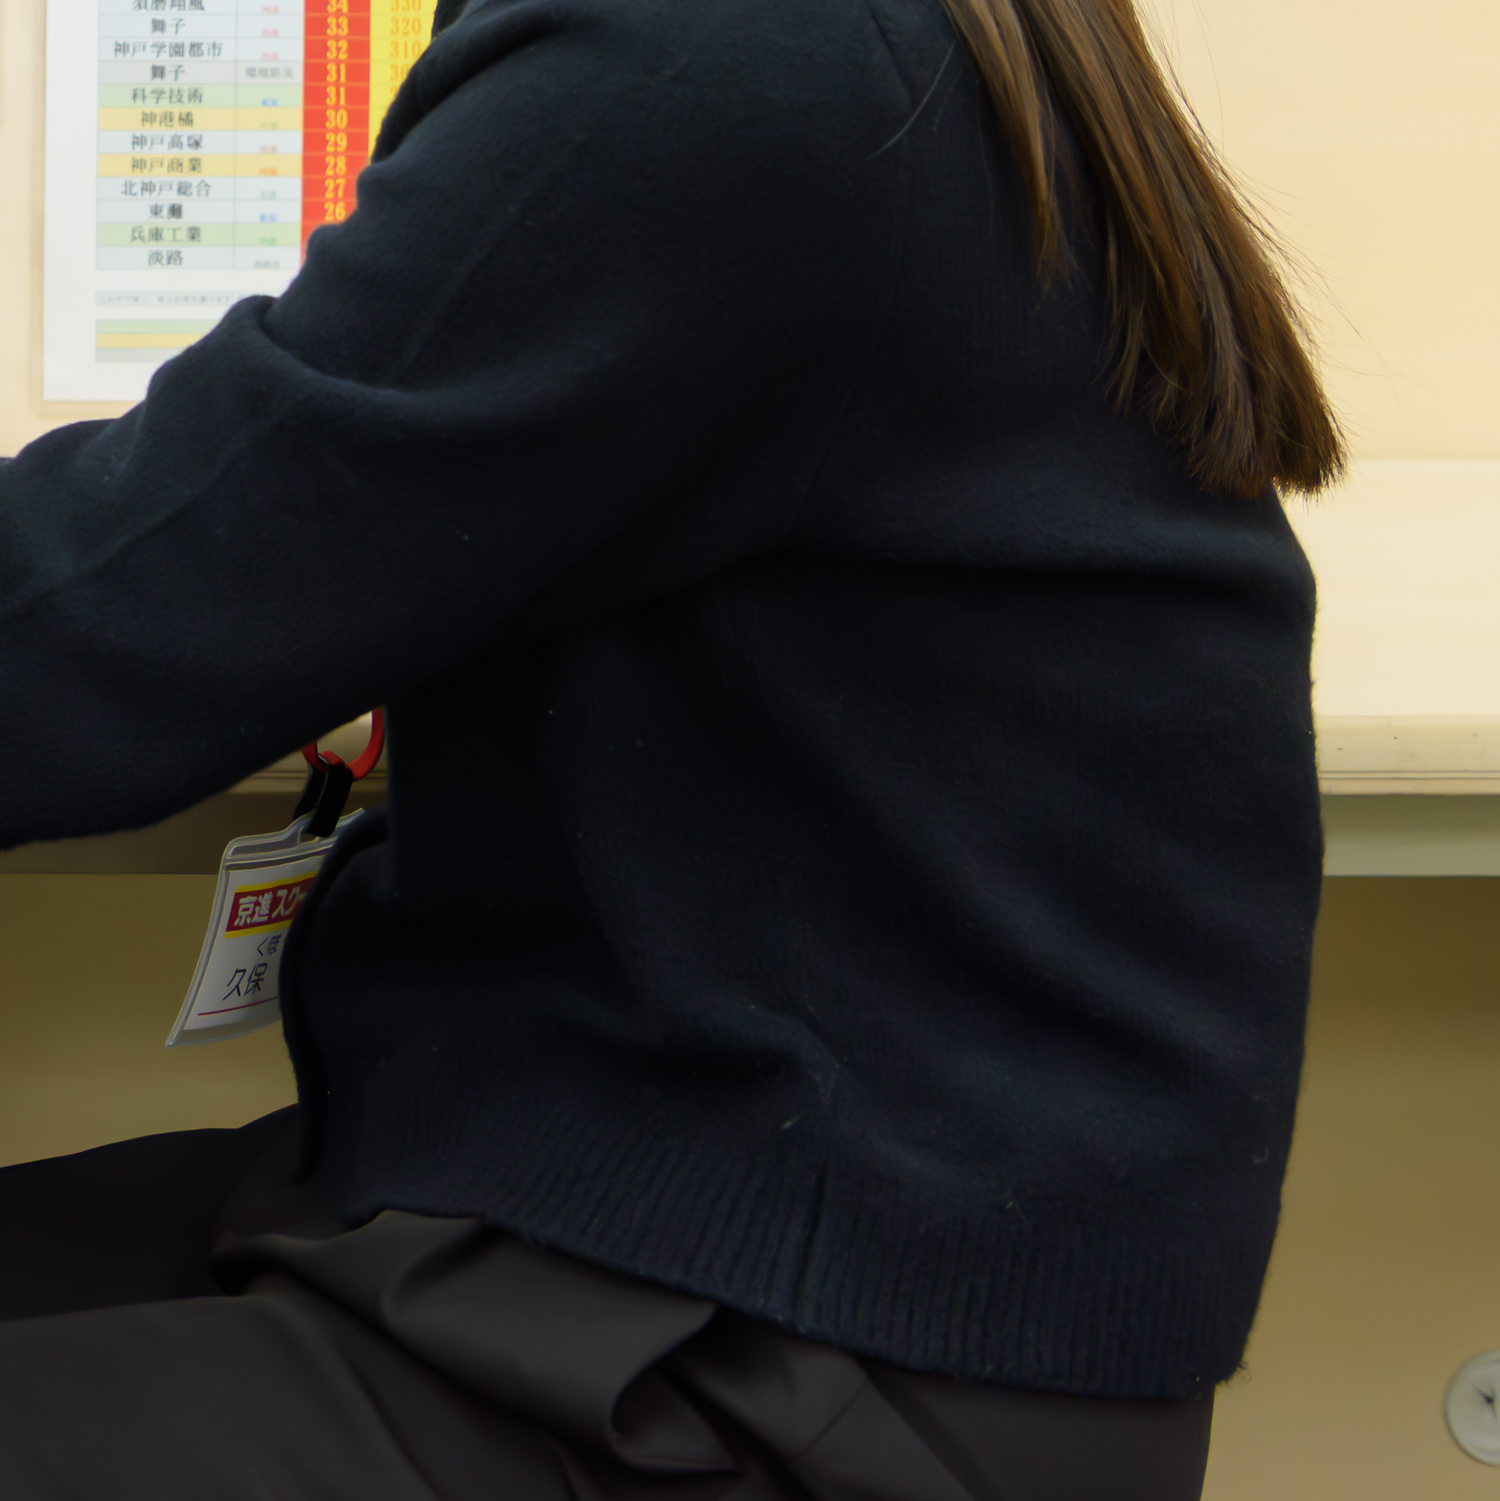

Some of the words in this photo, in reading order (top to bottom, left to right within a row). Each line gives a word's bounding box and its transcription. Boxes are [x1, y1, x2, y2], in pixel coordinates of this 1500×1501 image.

[150, 17, 186, 35] 舞子
[325, 16, 348, 35] 33
[113, 41, 221, 58] 神戸学園都市
[150, 63, 185, 82] 舞子
[325, 62, 348, 81] 31
[131, 86, 204, 105] 科学技術
[140, 110, 195, 129] 神港橘
[325, 109, 348, 128] 30
[130, 133, 203, 151] 神戸高塚
[130, 156, 202, 174] 神戸商業
[324, 155, 347, 174] 28
[121, 179, 212, 198] 北神戸総合
[149, 202, 184, 220] 東灘
[324, 201, 347, 220] 26
[130, 225, 202, 243] 兵庫工業
[147, 248, 184, 267] 淡路
[222, 962, 268, 1001] 久保
